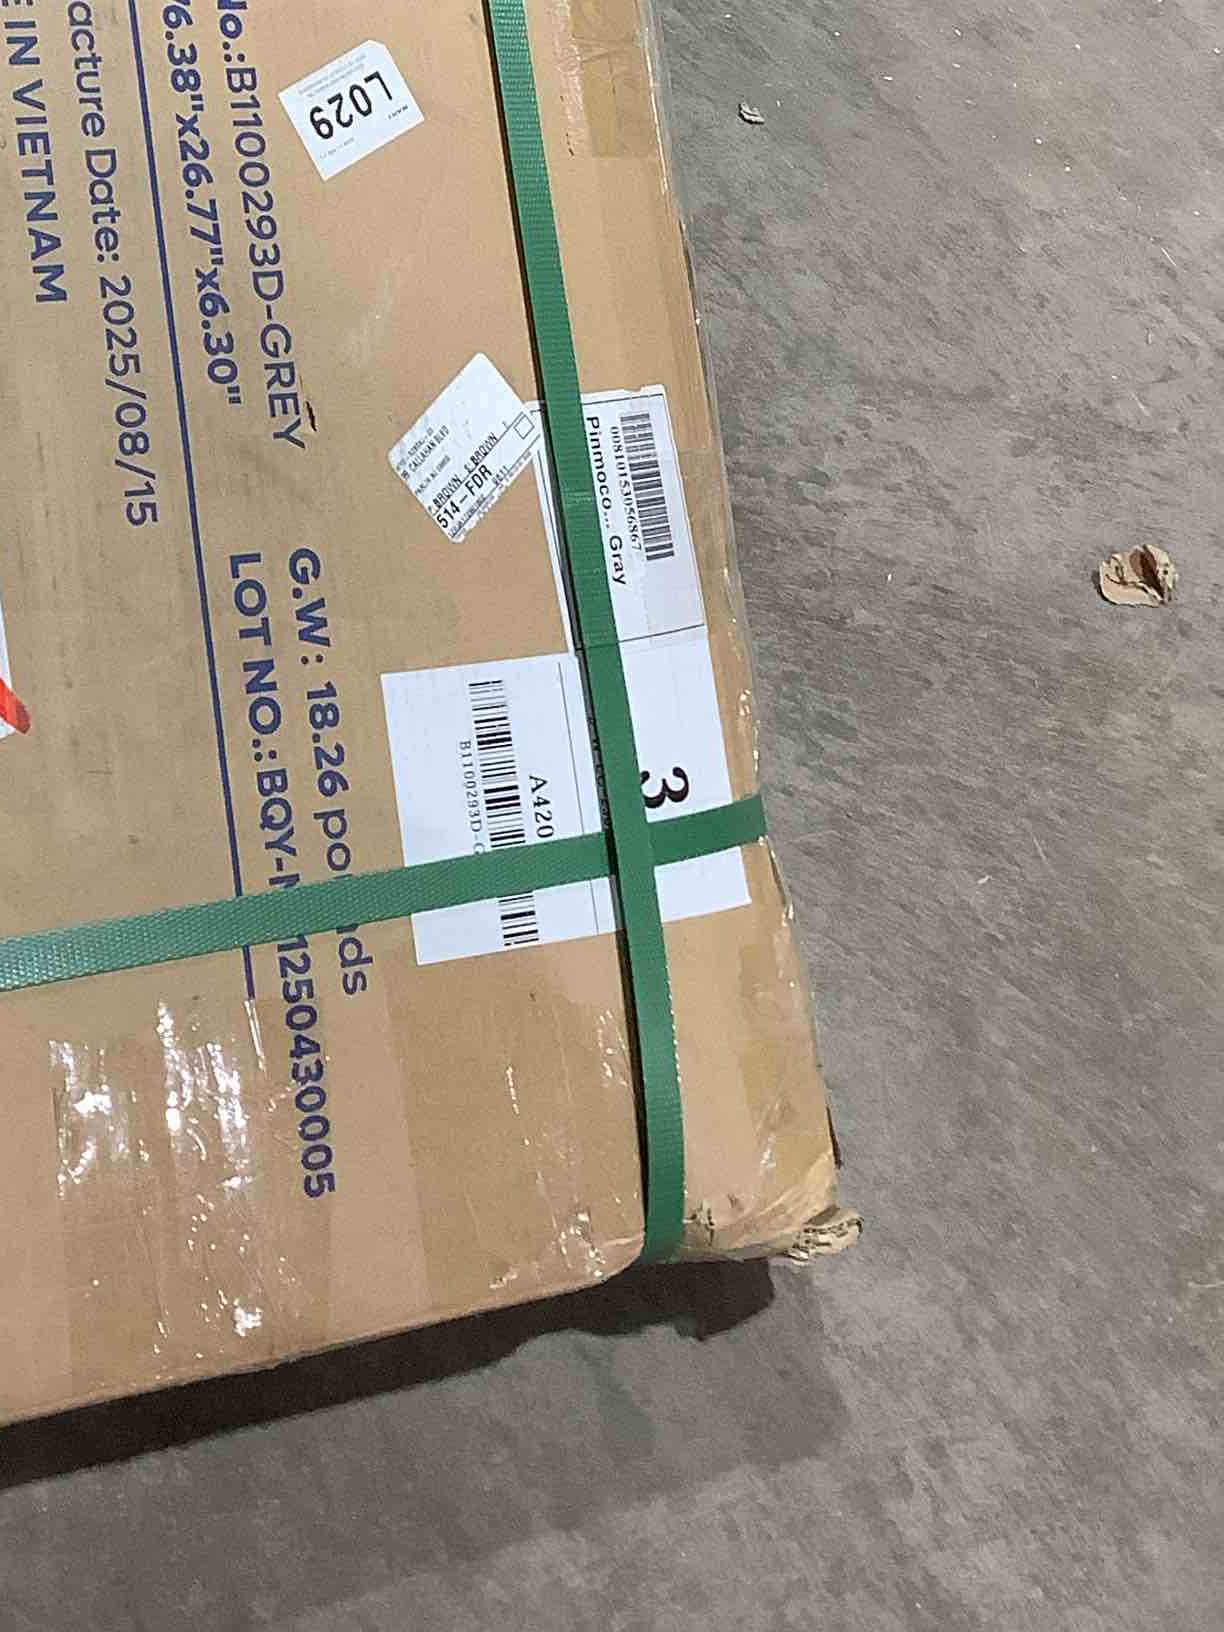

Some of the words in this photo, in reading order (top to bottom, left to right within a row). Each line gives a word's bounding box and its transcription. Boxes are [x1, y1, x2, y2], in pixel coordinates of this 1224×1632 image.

[2, 20, 42, 67] IN
[310, 71, 394, 142] L029
[12, 79, 68, 304] VIETNAM
[85, 148, 120, 264] Date:
[100, 274, 160, 528] 2025/08/15
[229, 552, 272, 646] LOT
[609, 535, 627, 585] Gray
[306, 680, 350, 798] 18.26
[528, 774, 555, 839] A420
[640, 767, 690, 809] 3
[313, 809, 373, 995] pods
